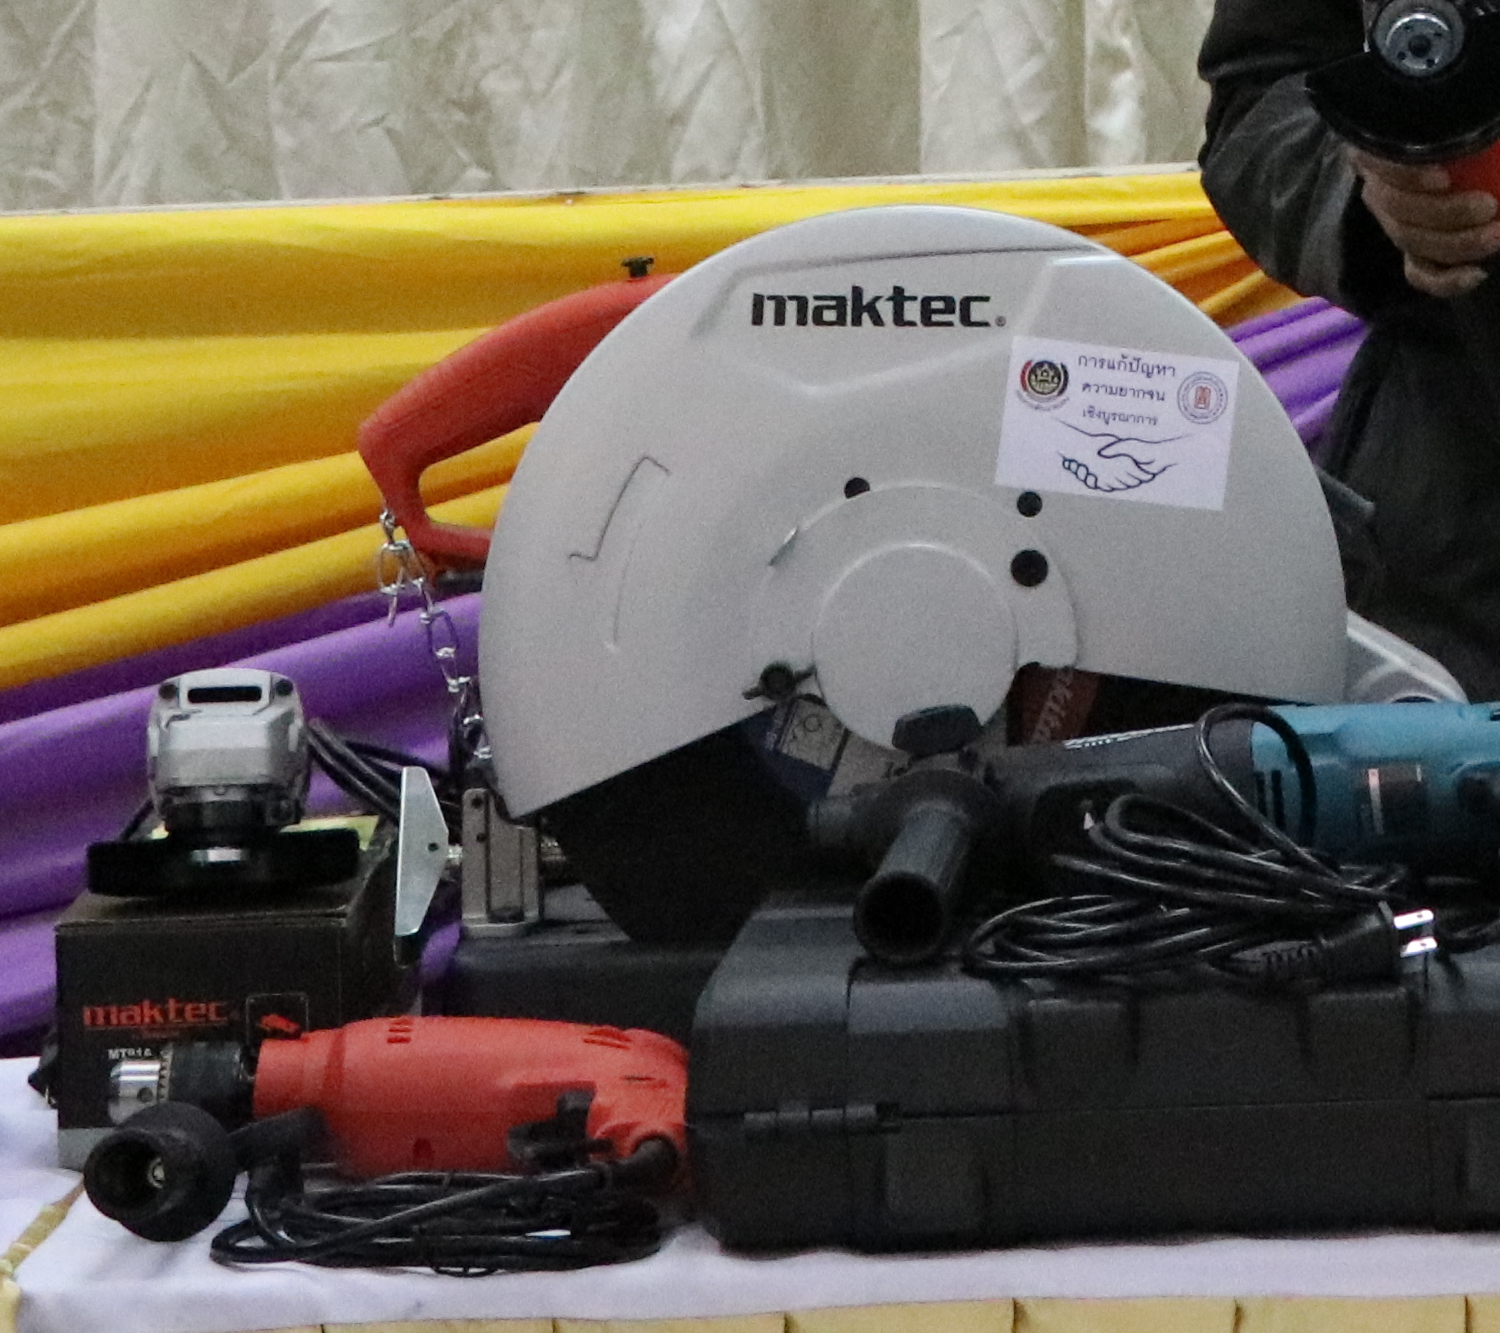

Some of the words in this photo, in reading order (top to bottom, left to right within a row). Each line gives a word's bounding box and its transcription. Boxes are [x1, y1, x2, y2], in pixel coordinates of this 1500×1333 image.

[751, 285, 991, 329] maktec
[1077, 354, 1176, 378] การแก้ปัญหา
[83, 997, 230, 1027] maktec
